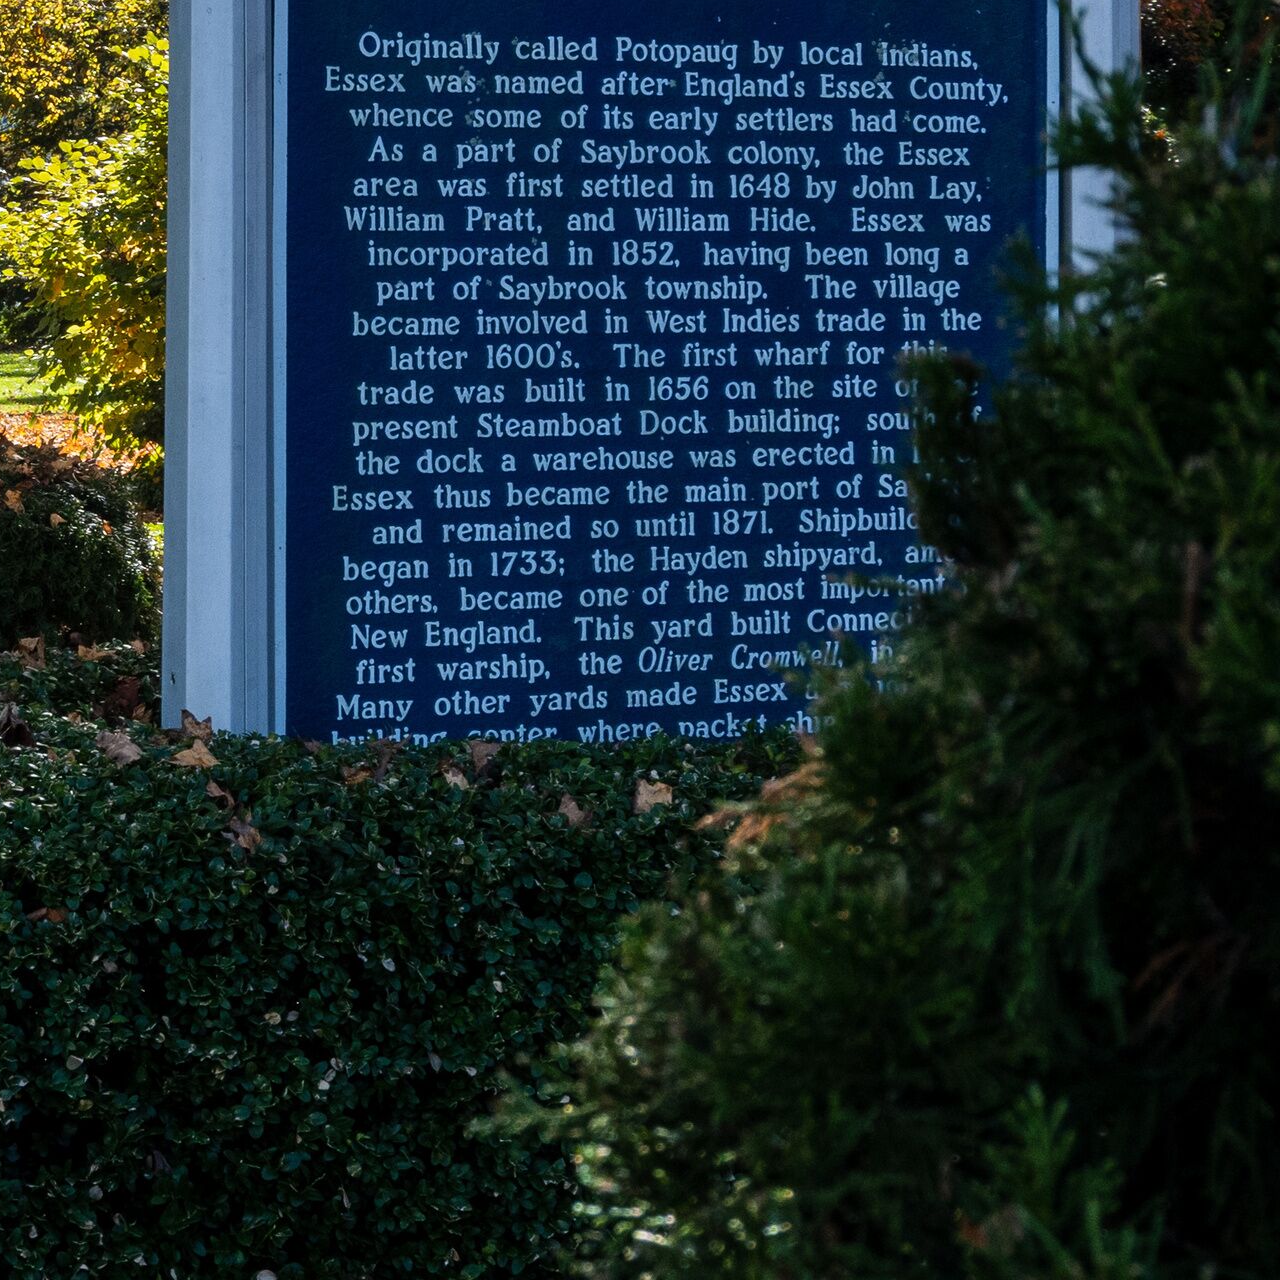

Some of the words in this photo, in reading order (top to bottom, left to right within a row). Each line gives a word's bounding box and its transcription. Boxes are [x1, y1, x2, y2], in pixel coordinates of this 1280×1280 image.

[358, 31, 500, 67] Originally
[515, 35, 598, 61] called
[615, 36, 738, 71] Potopaug
[753, 39, 784, 70] by
[800, 40, 863, 66] local
[881, 41, 978, 70] Indians,
[324, 65, 406, 93] Essex
[425, 72, 477, 94] was
[494, 70, 584, 95] named
[600, 70, 670, 96] after
[684, 70, 806, 106] England's
[819, 73, 894, 100] Essex
[909, 75, 1009, 107] County,
[348, 102, 454, 128] whence
[472, 108, 542, 129] some
[560, 104, 589, 129] of
[603, 103, 634, 130] its
[648, 106, 719, 137] early
[735, 107, 834, 132] settlers
[850, 107, 897, 133] had
[909, 114, 987, 134] come.
[367, 135, 404, 162] As
[422, 143, 438, 162] a
[456, 138, 516, 169] part
[533, 137, 563, 163] of
[580, 138, 712, 170] Saybrook
[727, 140, 821, 171] colony,
[842, 141, 884, 166] the
[898, 140, 971, 166] Essex
[353, 176, 418, 197] area
[437, 178, 487, 198] was
[505, 171, 564, 198] first
[581, 173, 674, 199] settled
[690, 172, 715, 199] in
[729, 171, 791, 199] 1648
[805, 174, 837, 204] by
[852, 174, 915, 200] John
[929, 175, 982, 204] Lay,
[343, 204, 445, 232] William
[465, 205, 543, 234] Pratt,
[567, 207, 616, 232] and
[634, 206, 730, 232] William
[750, 206, 816, 232] Hide.
[851, 206, 925, 233] Essex
[944, 214, 991, 233] was
[367, 239, 549, 272] incorporated
[568, 239, 594, 266] in
[612, 239, 680, 268] 1852,
[703, 240, 791, 273] having
[805, 241, 869, 266] been
[884, 241, 940, 273] long
[954, 247, 970, 266] a
[376, 277, 435, 307] part
[452, 275, 482, 301] of
[498, 274, 628, 306] Saybrook
[644, 273, 768, 305] township.
[804, 273, 857, 300] The
[872, 272, 961, 307] village
[352, 311, 461, 337] became
[476, 308, 588, 335] involved
[604, 307, 629, 334] in
[645, 309, 707, 334] West
[722, 307, 800, 333] Indies
[815, 307, 886, 333] trade
[902, 306, 926, 332] in
[940, 307, 982, 331] the
[389, 345, 468, 371] latter
[486, 340, 580, 369] 1600's.
[612, 343, 666, 368] The
[682, 341, 738, 368] first
[753, 340, 831, 366] wharf
[845, 340, 885, 365] for
[357, 379, 435, 406] trade
[453, 384, 505, 404] was
[524, 377, 586, 403] built
[604, 375, 631, 402] in
[648, 375, 709, 401] 1656
[724, 381, 757, 400] on
[773, 375, 815, 399] the
[831, 373, 878, 398] site
[352, 415, 458, 447] present
[476, 412, 622, 438] Steamboat
[639, 409, 709, 436] Dock
[727, 407, 840, 440] building;
[355, 450, 401, 476] the
[416, 447, 484, 474] dock
[501, 453, 517, 472] a
[532, 446, 674, 472] warehouse
[688, 449, 737, 468] was
[752, 440, 855, 467] erected
[871, 439, 896, 464] in
[332, 485, 414, 511] Essex
[433, 483, 491, 509] thus
[506, 481, 610, 507] became
[626, 479, 669, 504] the
[684, 476, 747, 503] main
[762, 476, 820, 507] port
[835, 473, 863, 499] of
[372, 518, 423, 545] and
[442, 514, 572, 543] remained
[590, 519, 620, 539] so
[635, 510, 696, 537] until
[712, 508, 774, 536] 1871.
[342, 555, 430, 588] began
[448, 552, 473, 578] in
[490, 549, 565, 577] 1733;
[591, 548, 635, 574] the
[650, 545, 749, 576] Hayden
[763, 540, 883, 572] shipyard,
[345, 589, 438, 615] others,
[460, 586, 563, 612] became
[579, 587, 629, 608] one
[641, 580, 670, 606] of
[686, 578, 729, 604] the
[743, 577, 805, 602] most
[350, 623, 409, 650] New
[424, 618, 542, 654] England.
[573, 614, 634, 642] This
[650, 612, 713, 645] yard
[730, 609, 791, 636] built
[355, 657, 416, 685] first
[436, 652, 551, 684] warship,
[578, 651, 623, 676] the
[638, 646, 714, 673] Oliver
[335, 694, 414, 722] Many
[434, 690, 511, 716] other
[529, 684, 608, 717] yards
[625, 681, 697, 708] made
[713, 678, 788, 704] Essex
[577, 719, 661, 743] where
